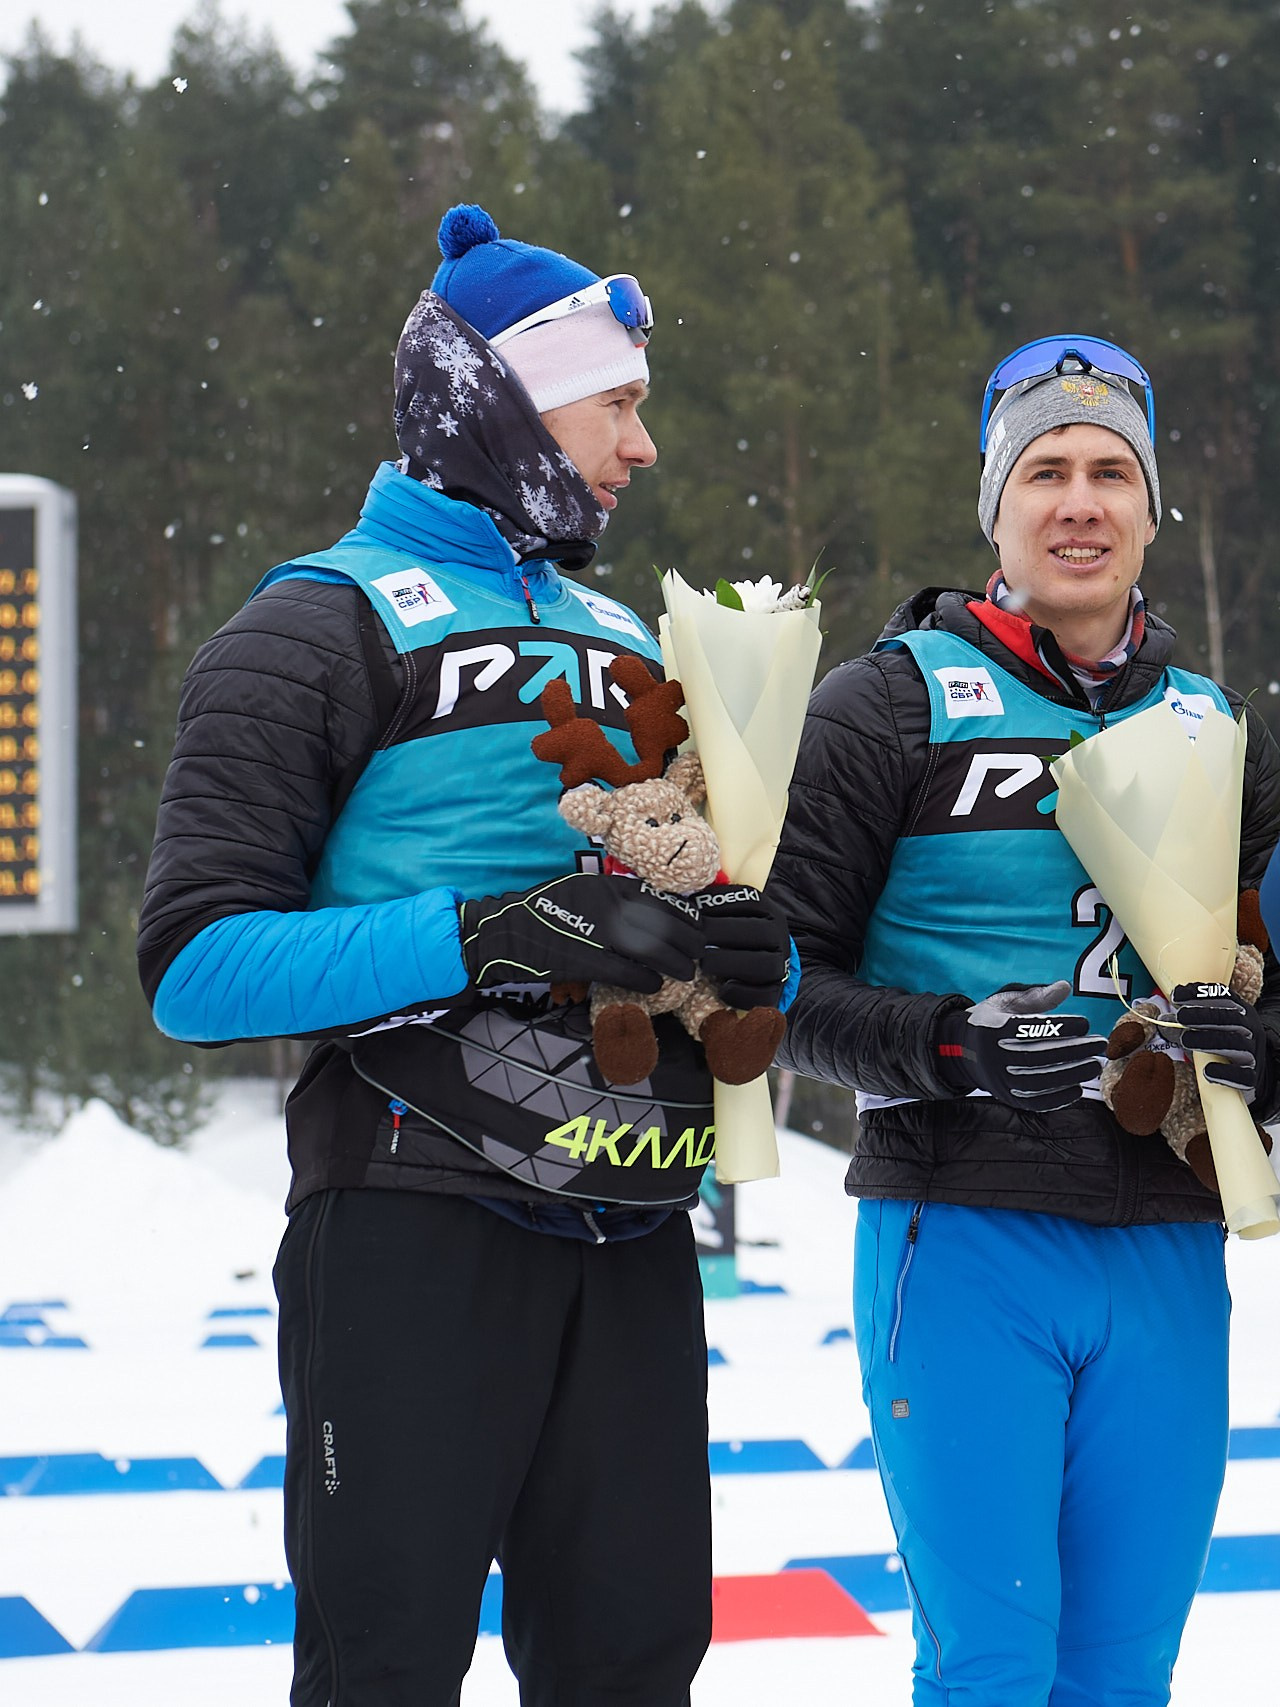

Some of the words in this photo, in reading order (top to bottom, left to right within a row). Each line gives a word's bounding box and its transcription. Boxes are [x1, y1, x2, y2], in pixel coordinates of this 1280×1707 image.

[431, 640, 632, 720] PAR
[1070, 882, 1132, 999] 2
[323, 1421, 337, 1479] CRAFT
